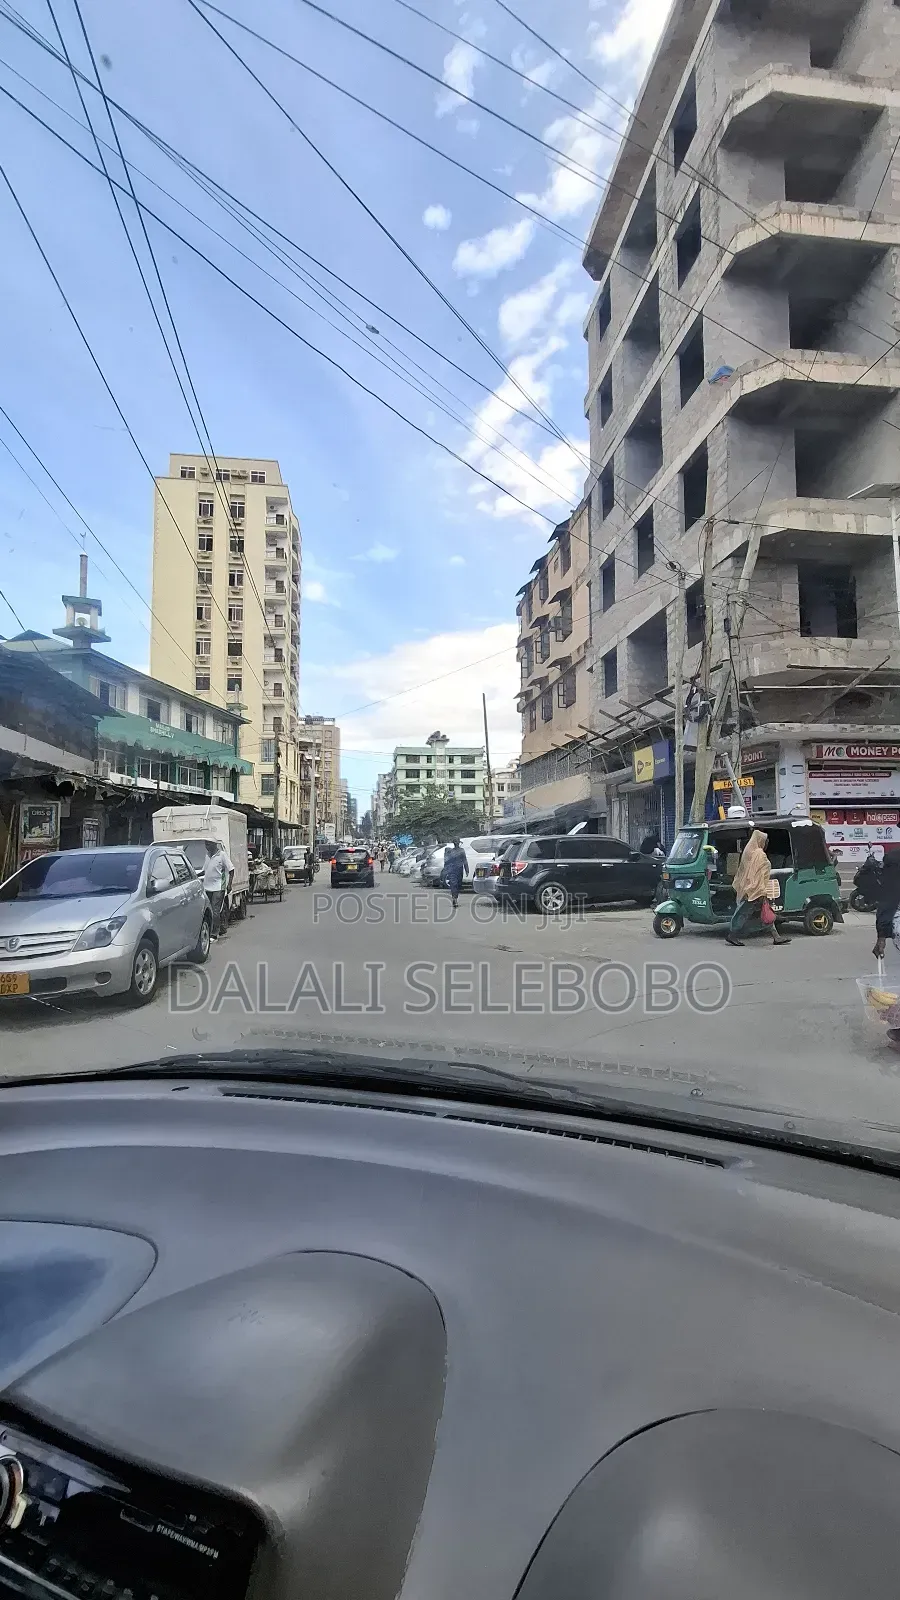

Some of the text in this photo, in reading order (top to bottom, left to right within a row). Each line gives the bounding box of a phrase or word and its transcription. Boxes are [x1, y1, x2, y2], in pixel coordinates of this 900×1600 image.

[744, 751, 764, 762] POINT
[851, 747, 888, 756] MONEY
[892, 747, 900, 756] P
